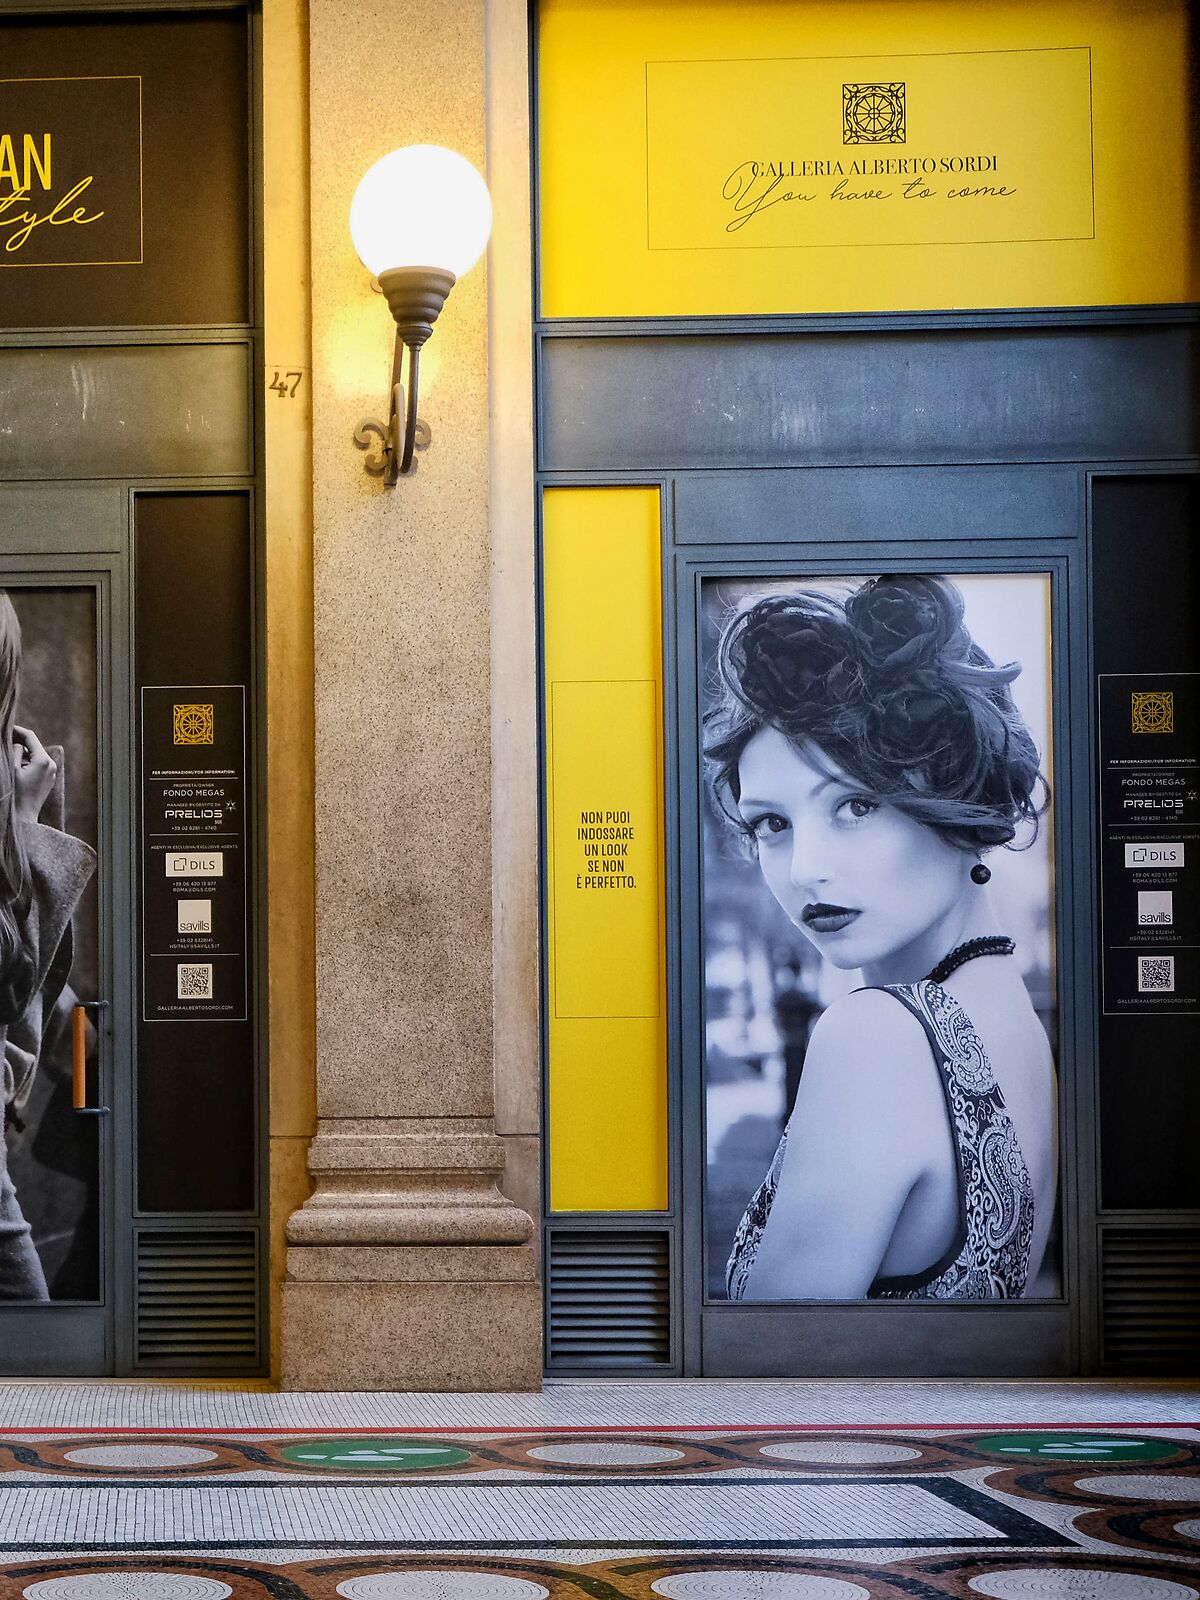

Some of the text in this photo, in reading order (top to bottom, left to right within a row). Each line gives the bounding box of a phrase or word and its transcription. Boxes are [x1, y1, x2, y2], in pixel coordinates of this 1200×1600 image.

[751, 155, 999, 178] GALLERIA ALBERTO SORDI
[722, 160, 1018, 233] You have to come
[268, 371, 303, 399] 47
[1121, 778, 1186, 786] FONDO MEGAS
[163, 788, 225, 797] FONDO MEGAS
[1123, 799, 1184, 809] PRELIOS
[164, 809, 223, 819] PRELIOS
[581, 811, 630, 824] NON PUOI
[577, 827, 634, 840] INDOSSARE
[584, 843, 628, 856] UN LOOK
[1150, 851, 1177, 861] DILS
[190, 860, 215, 870] DILS
[587, 859, 624, 873] SE NON
[576, 873, 637, 889] È PERFETTO.
[1139, 911, 1171, 923] savills
[179, 920, 210, 931] savills
